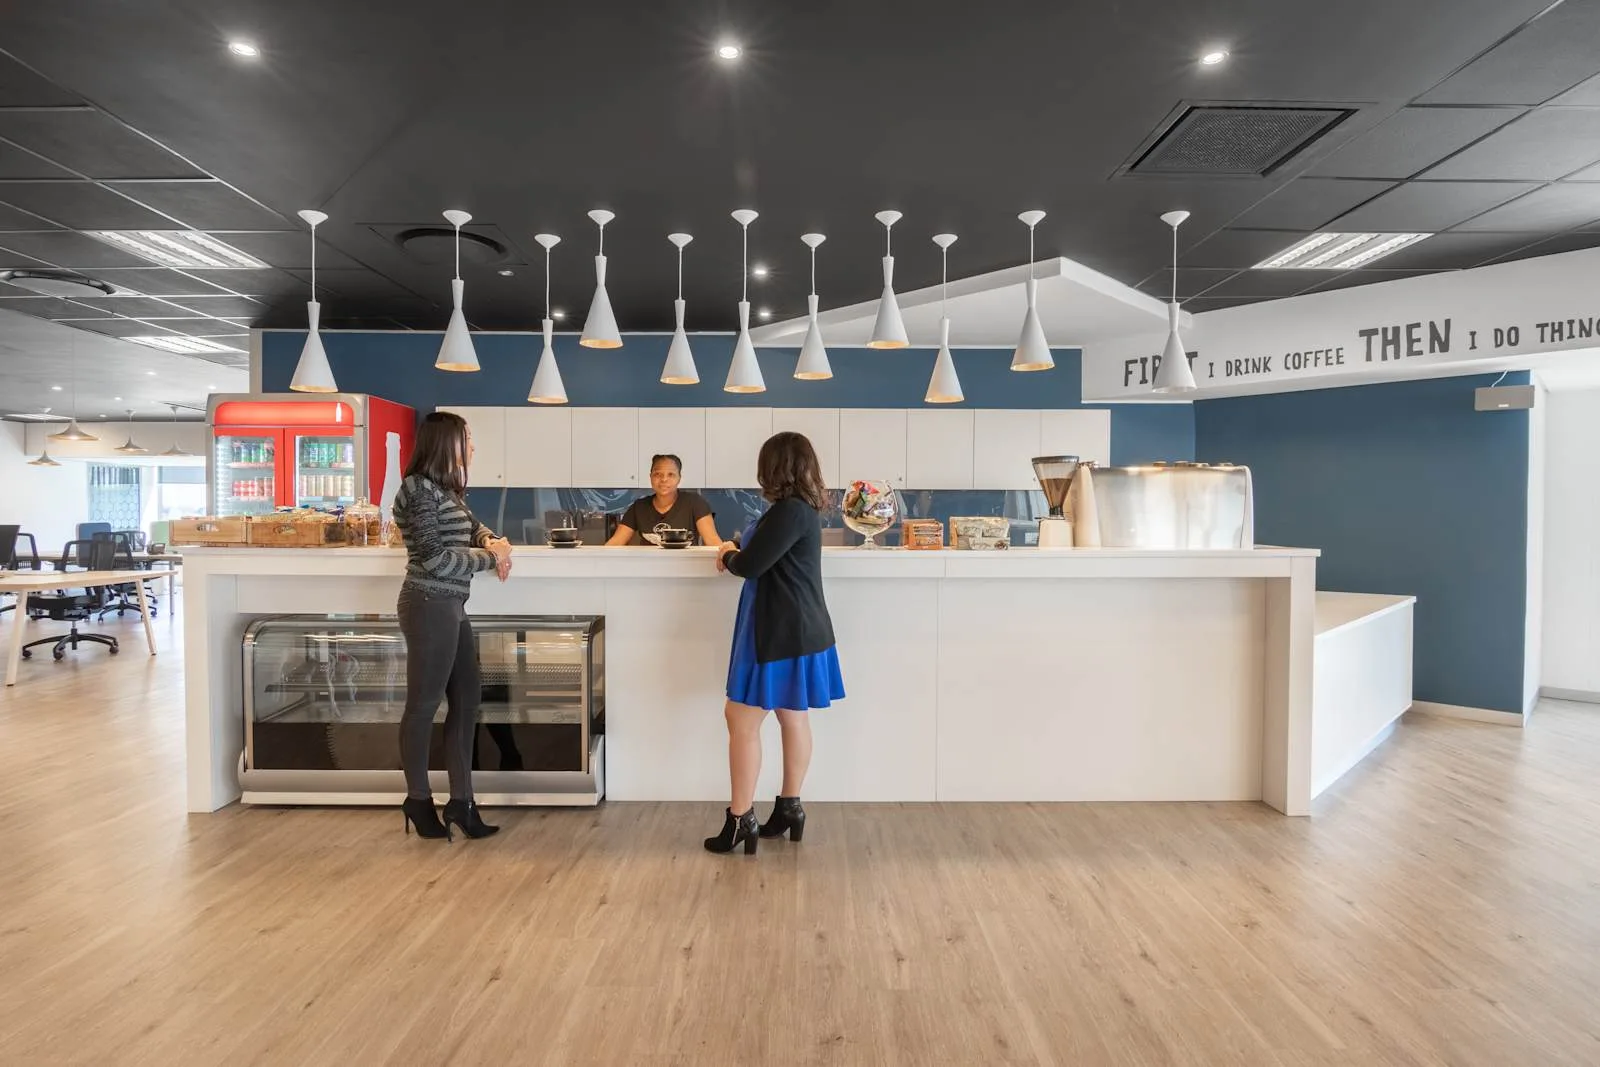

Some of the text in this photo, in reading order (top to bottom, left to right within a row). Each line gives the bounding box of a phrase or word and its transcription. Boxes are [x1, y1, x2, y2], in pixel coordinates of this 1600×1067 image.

[1123, 351, 1199, 387] FIRT
[1208, 361, 1214, 378] I
[1225, 356, 1272, 377] DRINK
[1284, 347, 1345, 370] COFFEE
[1358, 318, 1451, 362] THEN
[1468, 330, 1478, 350] I
[1493, 326, 1520, 348] DO
